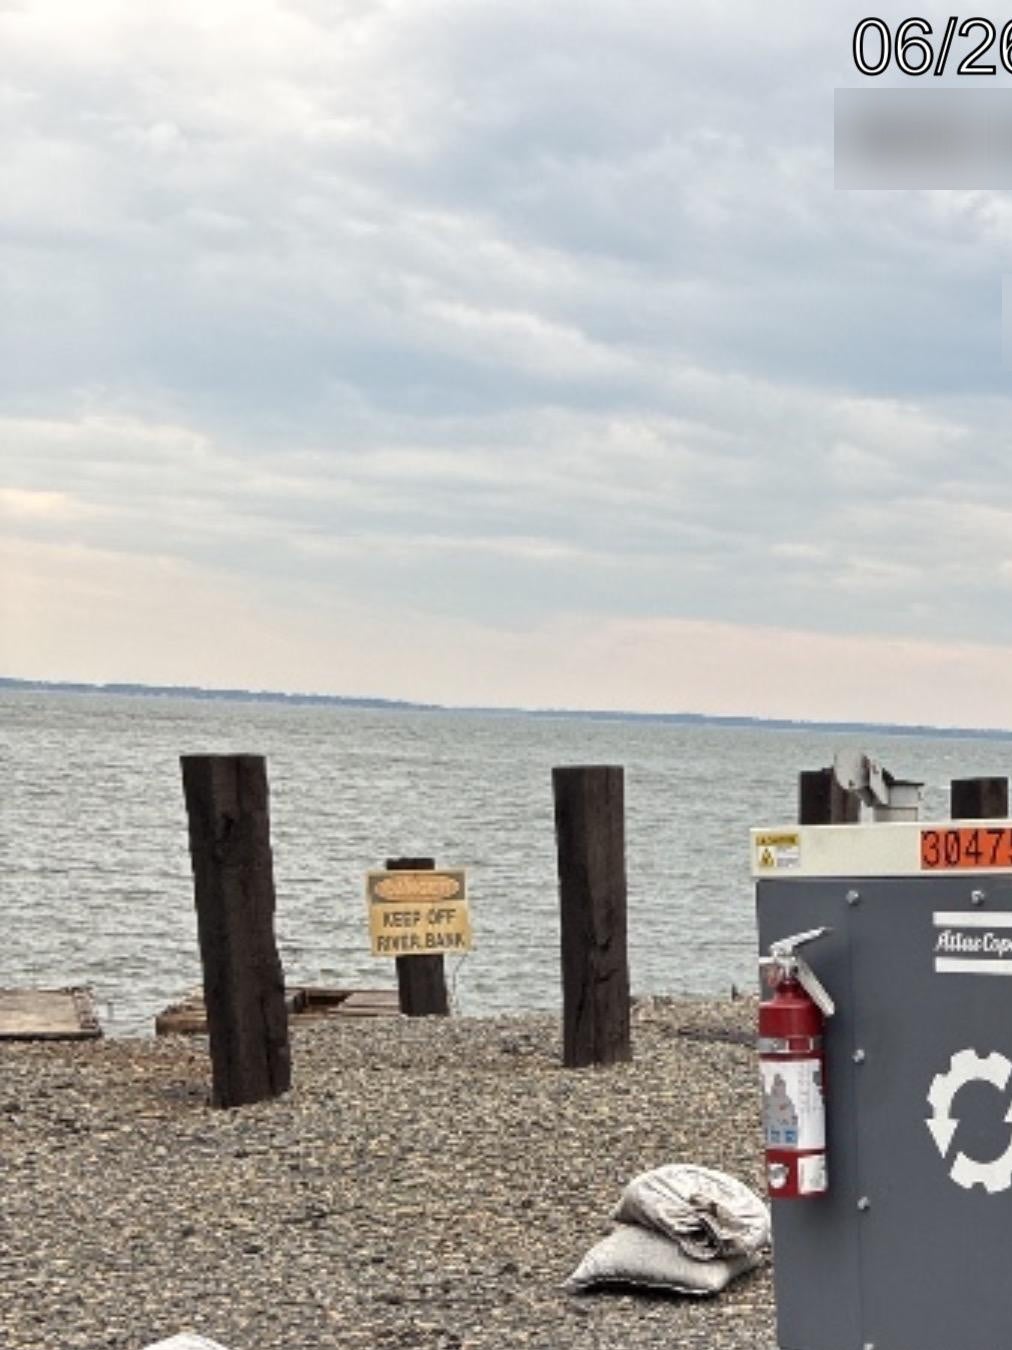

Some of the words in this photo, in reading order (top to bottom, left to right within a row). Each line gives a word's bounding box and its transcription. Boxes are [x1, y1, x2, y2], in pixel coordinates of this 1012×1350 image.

[383, 910, 420, 928] KEEP
[427, 908, 457, 925] OFF
[376, 934, 421, 952] RIVER
[425, 932, 465, 949] BANK
